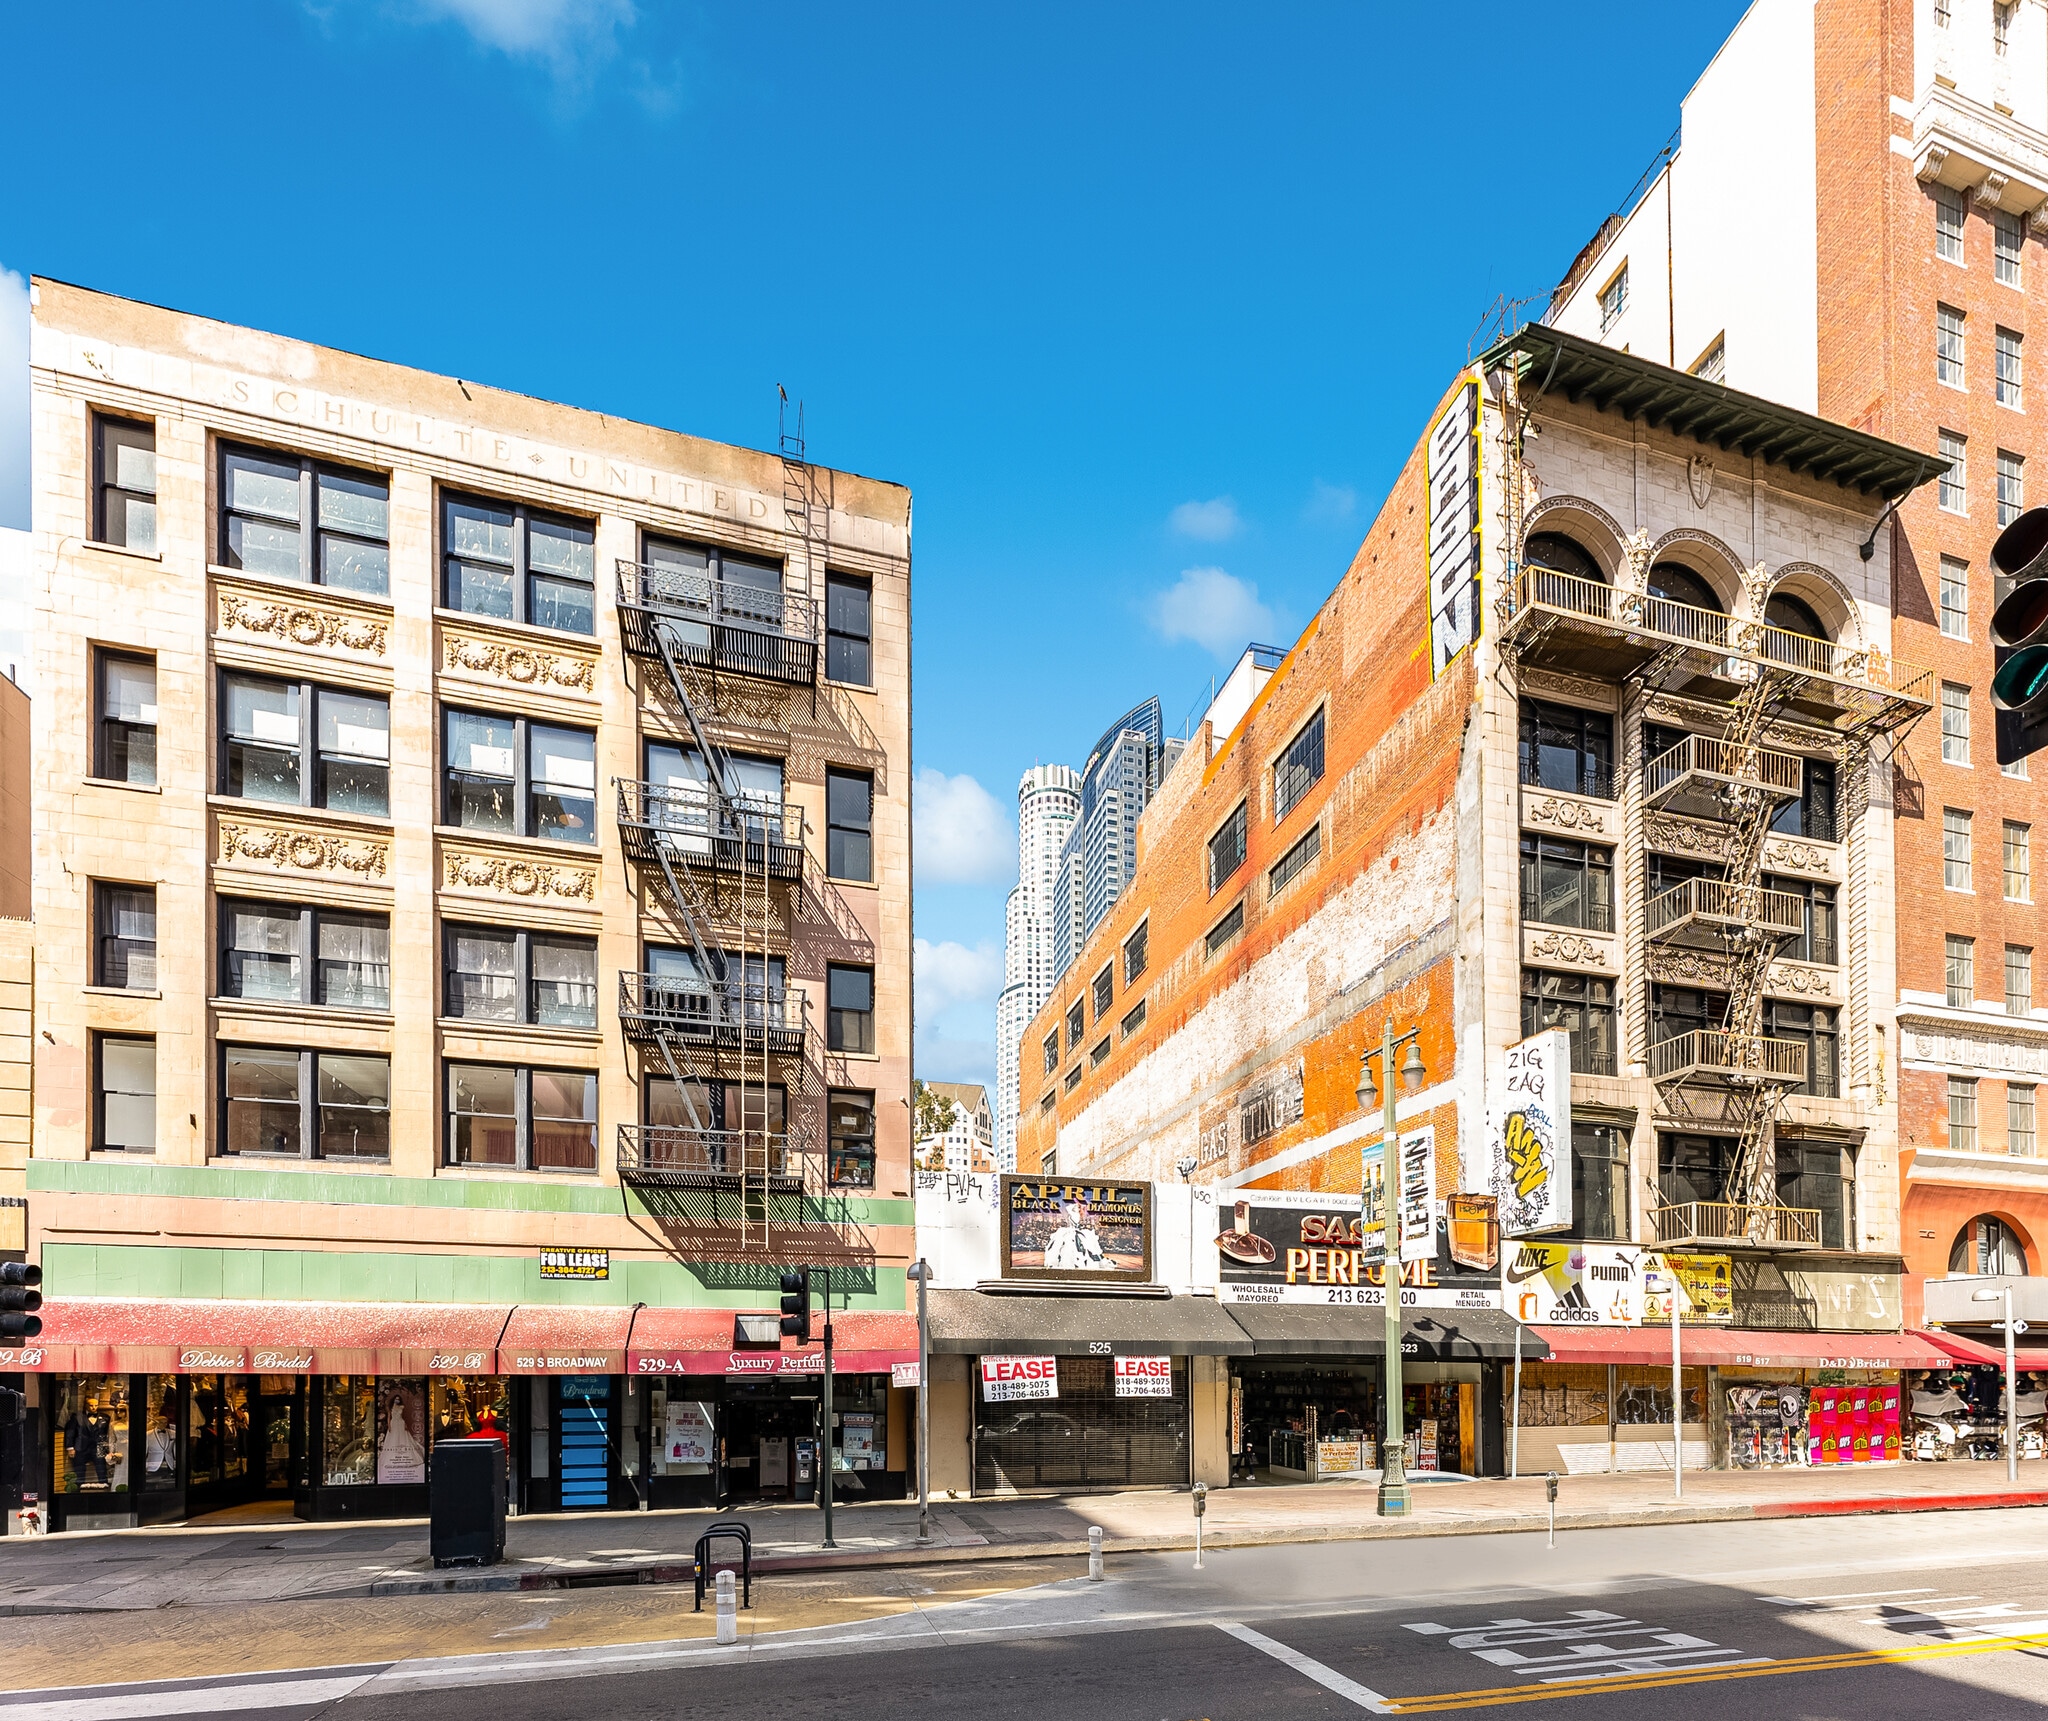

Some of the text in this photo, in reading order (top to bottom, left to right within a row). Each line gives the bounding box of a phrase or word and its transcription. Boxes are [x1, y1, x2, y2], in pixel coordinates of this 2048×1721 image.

[233, 381, 768, 519] SCHULTE UNITED
[1012, 1184, 1128, 1203] APRIL
[1404, 1137, 1430, 1241] LEHMAN
[1012, 1200, 1060, 1210] BLACK
[1099, 1215, 1142, 1225] DESIGNER
[541, 1252, 607, 1267] FOR LEASE
[1515, 1248, 1550, 1267] NIKE
[541, 1266, 595, 1274] 213-304-4727
[1591, 1265, 1629, 1281] PUMA
[1231, 1285, 1285, 1295] WHOLESALE
[1690, 1281, 1709, 1290] FILA
[1237, 1294, 1279, 1303] MAYOREO
[1327, 1289, 1352, 1303] 213
[1460, 1291, 1486, 1299] RETAIL
[1455, 1299, 1491, 1307] MENUDEO
[1550, 1308, 1599, 1321] adidas
[1089, 1342, 1112, 1355] 525
[179, 1351, 314, 1368] Debbie's Bridal
[429, 1353, 486, 1369] 529-B
[517, 1357, 608, 1368] 529 S BROADWAY
[638, 1358, 686, 1372] 529-A
[726, 1352, 774, 1371] Luxury
[1736, 1355, 1751, 1363] 519
[1755, 1357, 1770, 1365] 517
[1819, 1357, 1890, 1368] D&D Bridal
[1936, 1359, 1950, 1367] 517
[983, 1361, 1055, 1382] LEASE
[1115, 1361, 1169, 1376] LEASE
[563, 1384, 608, 1397] Broadway
[991, 1381, 1050, 1391] 818-489-5075
[1116, 1387, 1170, 1395] 213-706-4653
[991, 1390, 1050, 1400] 213-706-4653
[328, 1473, 358, 1485] LOVE
[1400, 1609, 1777, 1684] HERE
